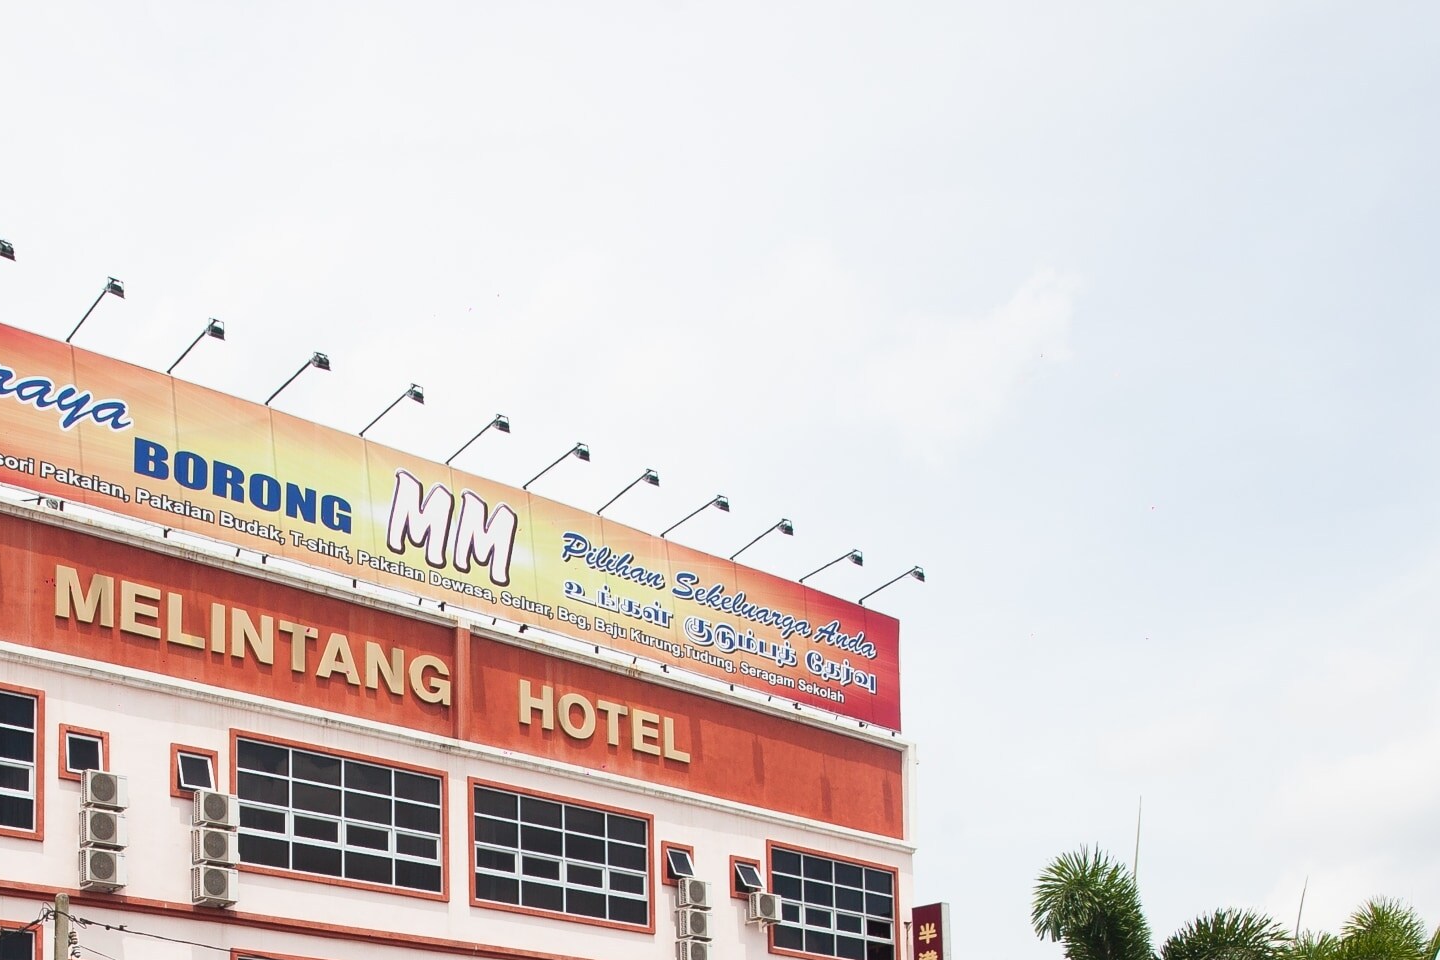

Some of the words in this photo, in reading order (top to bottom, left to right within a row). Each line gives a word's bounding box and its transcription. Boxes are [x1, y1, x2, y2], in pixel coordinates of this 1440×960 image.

[134, 437, 352, 533] BORONG
[387, 468, 518, 586] MM
[40, 460, 130, 503] Pakaian,
[135, 487, 216, 524] Pakaian
[219, 510, 285, 545] Budak,
[289, 530, 353, 564] T-shirt,
[357, 550, 425, 583] Pakaian
[428, 570, 497, 604] Dewasa,
[500, 590, 554, 620] Seluar,
[557, 605, 591, 631] Beg,
[594, 617, 628, 640] Baju
[740, 658, 795, 689] Seragam
[797, 680, 846, 703] Sekolah
[562, 532, 665, 589] Pilihan
[672, 571, 812, 643] Sekeluarga
[813, 619, 877, 659] Anda
[54, 563, 451, 706] MELINTANG
[518, 679, 691, 763] HOTEL
